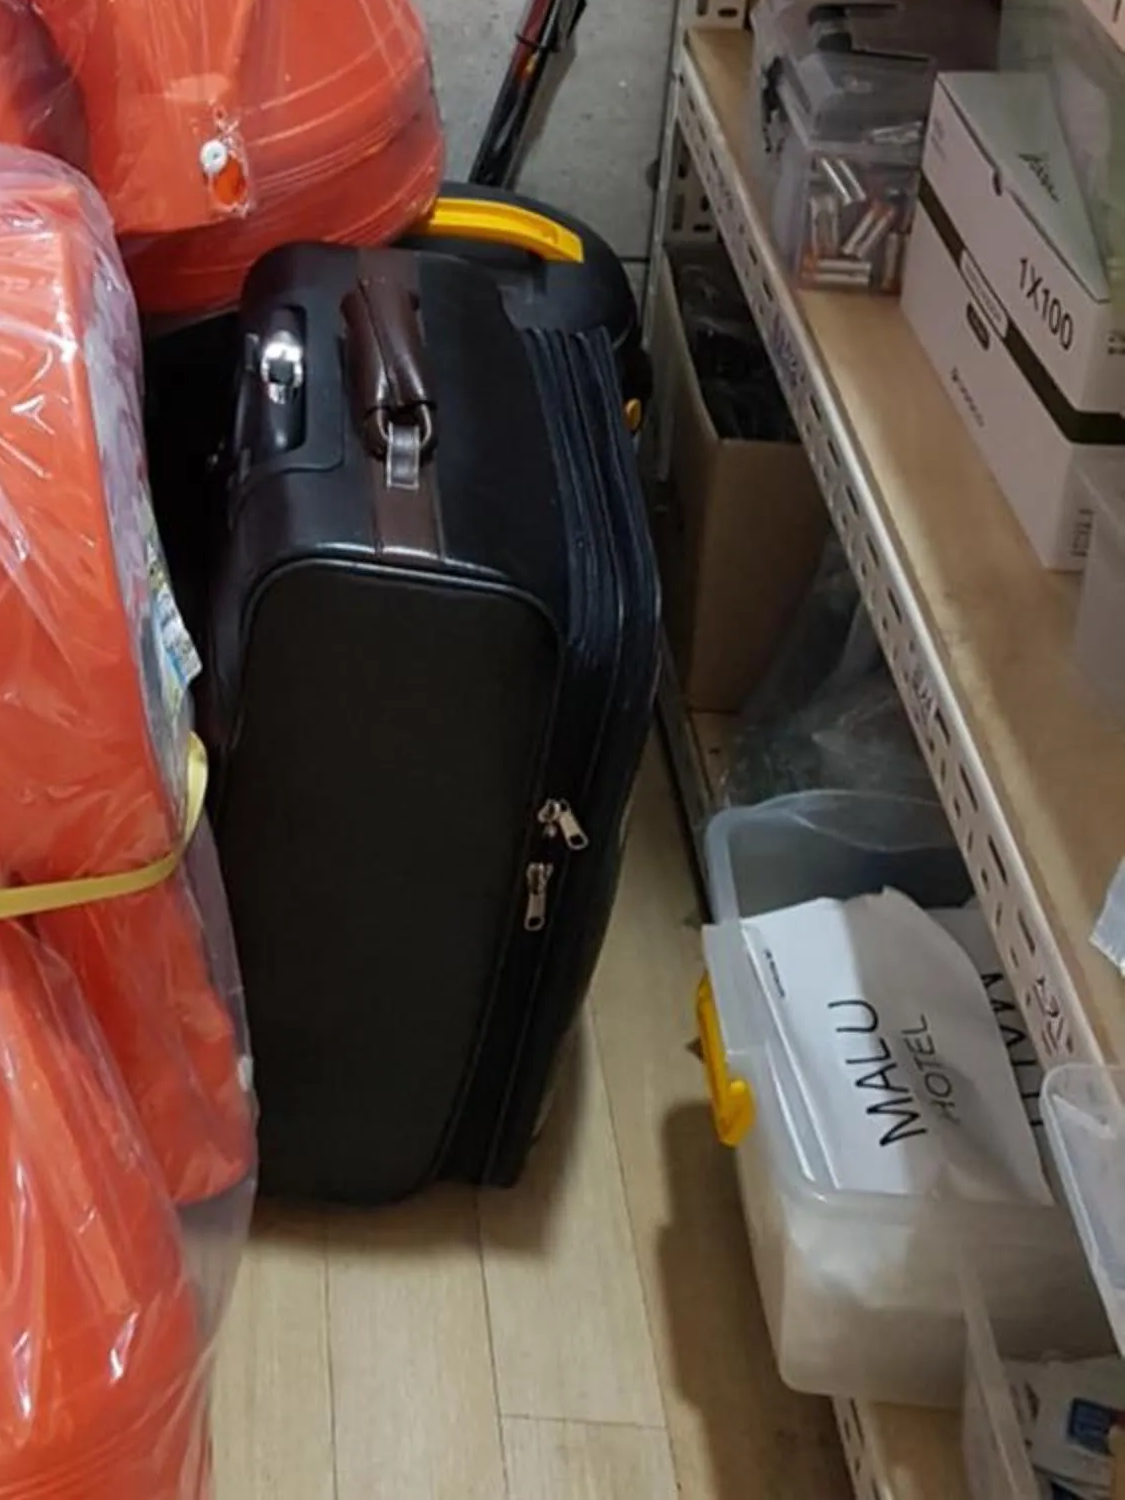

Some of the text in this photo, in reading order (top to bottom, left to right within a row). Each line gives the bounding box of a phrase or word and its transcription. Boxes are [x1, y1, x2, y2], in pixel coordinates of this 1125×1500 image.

[1019, 257, 1073, 351] 1X100
[827, 998, 928, 1147] MALU
[901, 1013, 961, 1126] HOTEL
